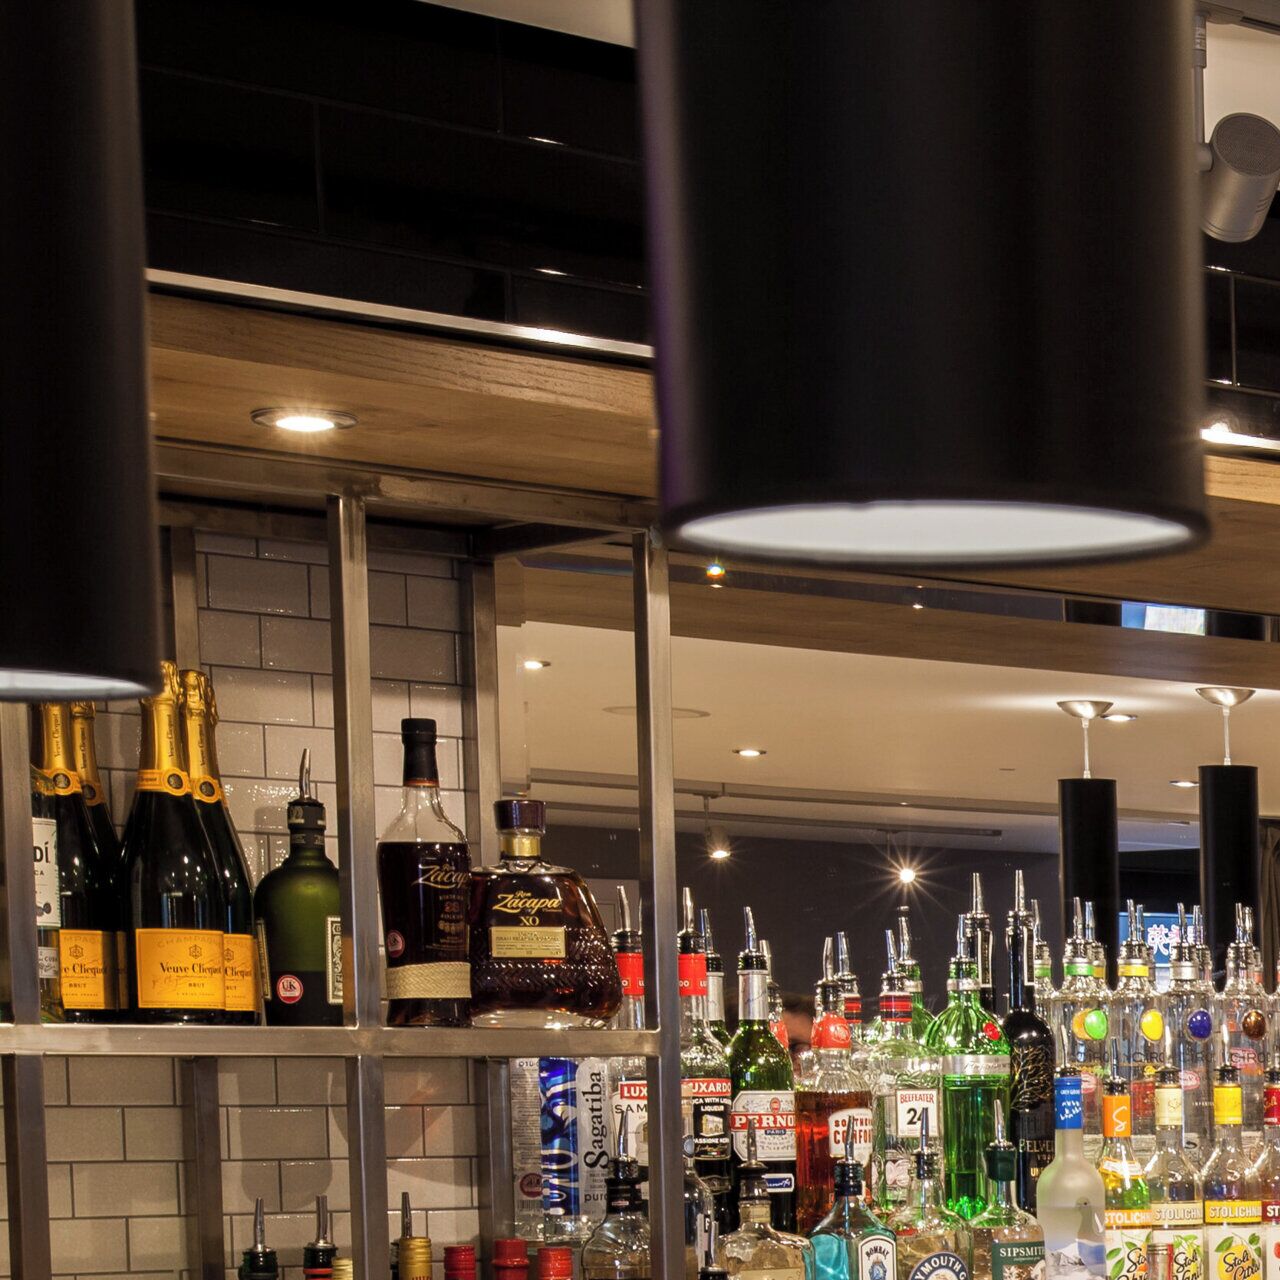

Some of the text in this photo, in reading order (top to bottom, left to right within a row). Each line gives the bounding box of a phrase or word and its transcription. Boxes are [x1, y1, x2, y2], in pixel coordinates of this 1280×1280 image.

[492, 893, 562, 915] Zacapa
[519, 916, 540, 926] XO
[160, 962, 222, 978] Veuve Clicquot
[624, 1086, 647, 1097] LUX
[691, 1083, 731, 1093] UXARDO
[900, 1093, 934, 1104] BEEFEATER
[582, 1071, 611, 1169] Sagatiba
[864, 1245, 890, 1261] BOMBAY
